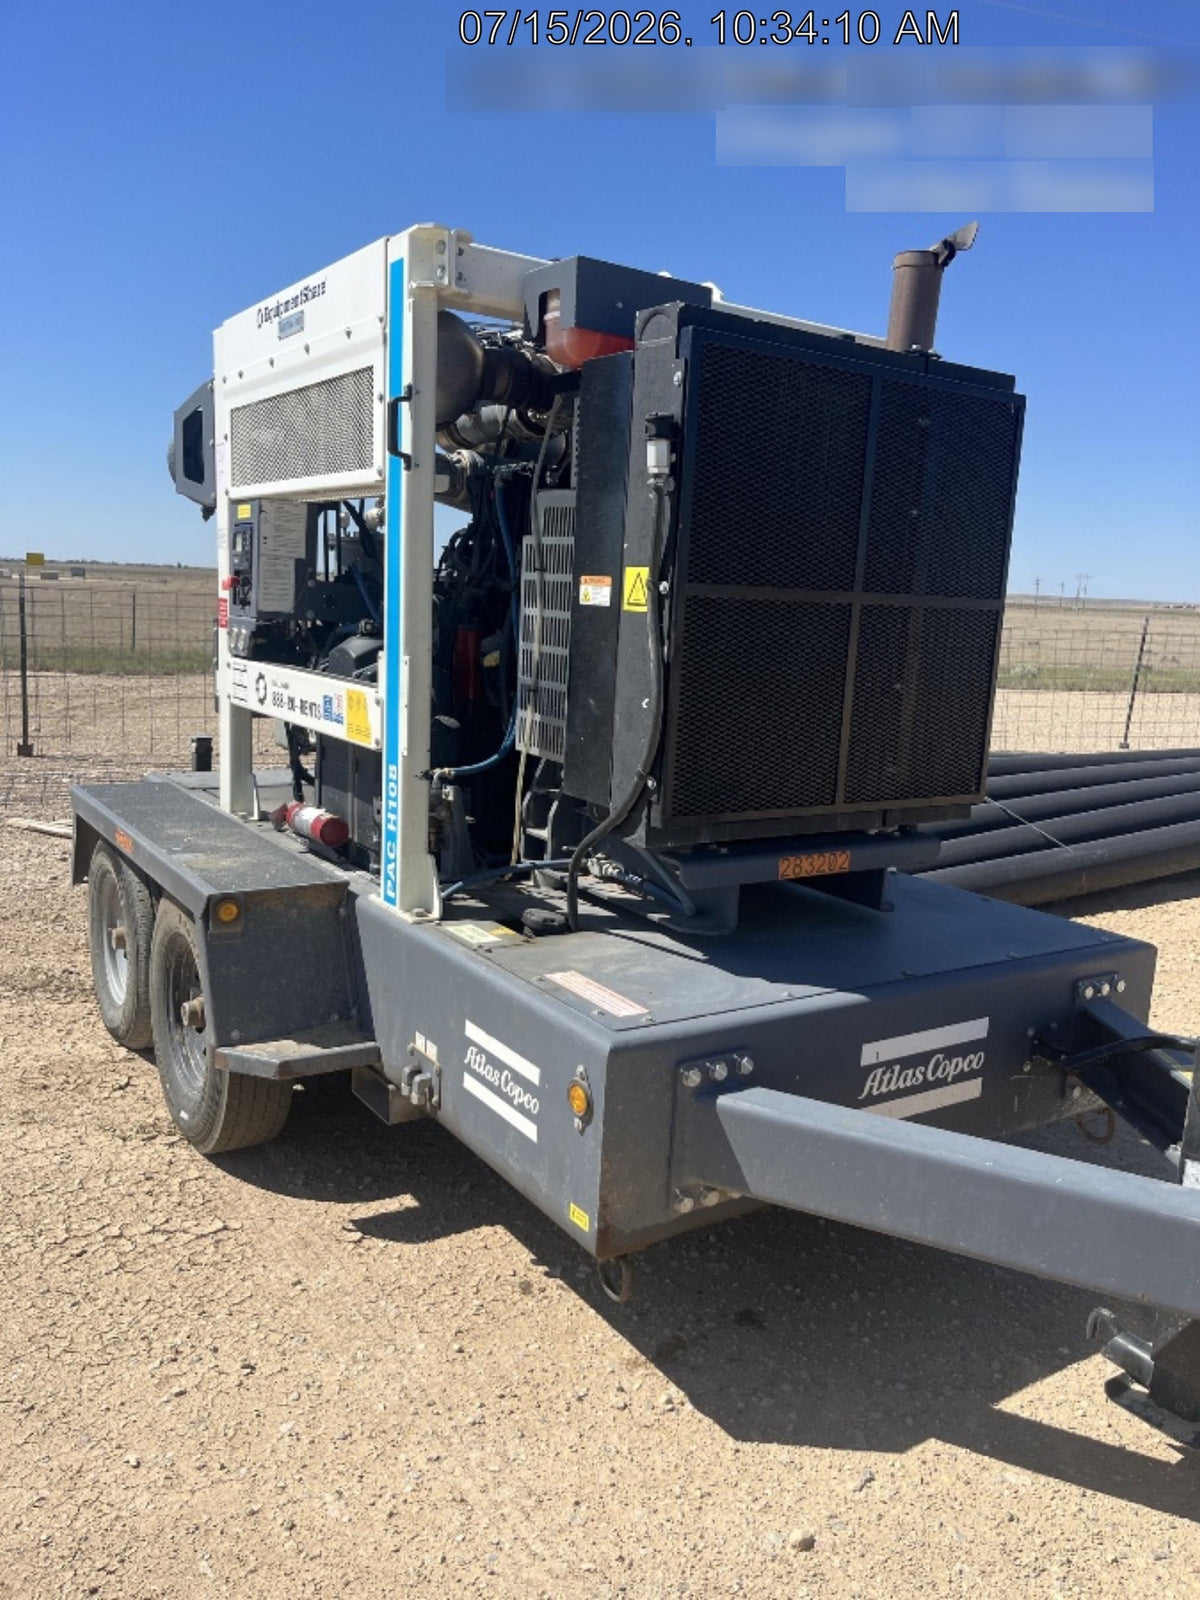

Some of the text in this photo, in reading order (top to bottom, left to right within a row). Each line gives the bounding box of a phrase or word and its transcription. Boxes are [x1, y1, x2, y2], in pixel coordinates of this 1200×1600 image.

[386, 763, 398, 899] PAC H108
[463, 1046, 540, 1115] Atlas Copco
[857, 1051, 985, 1100] Atlas Copco
